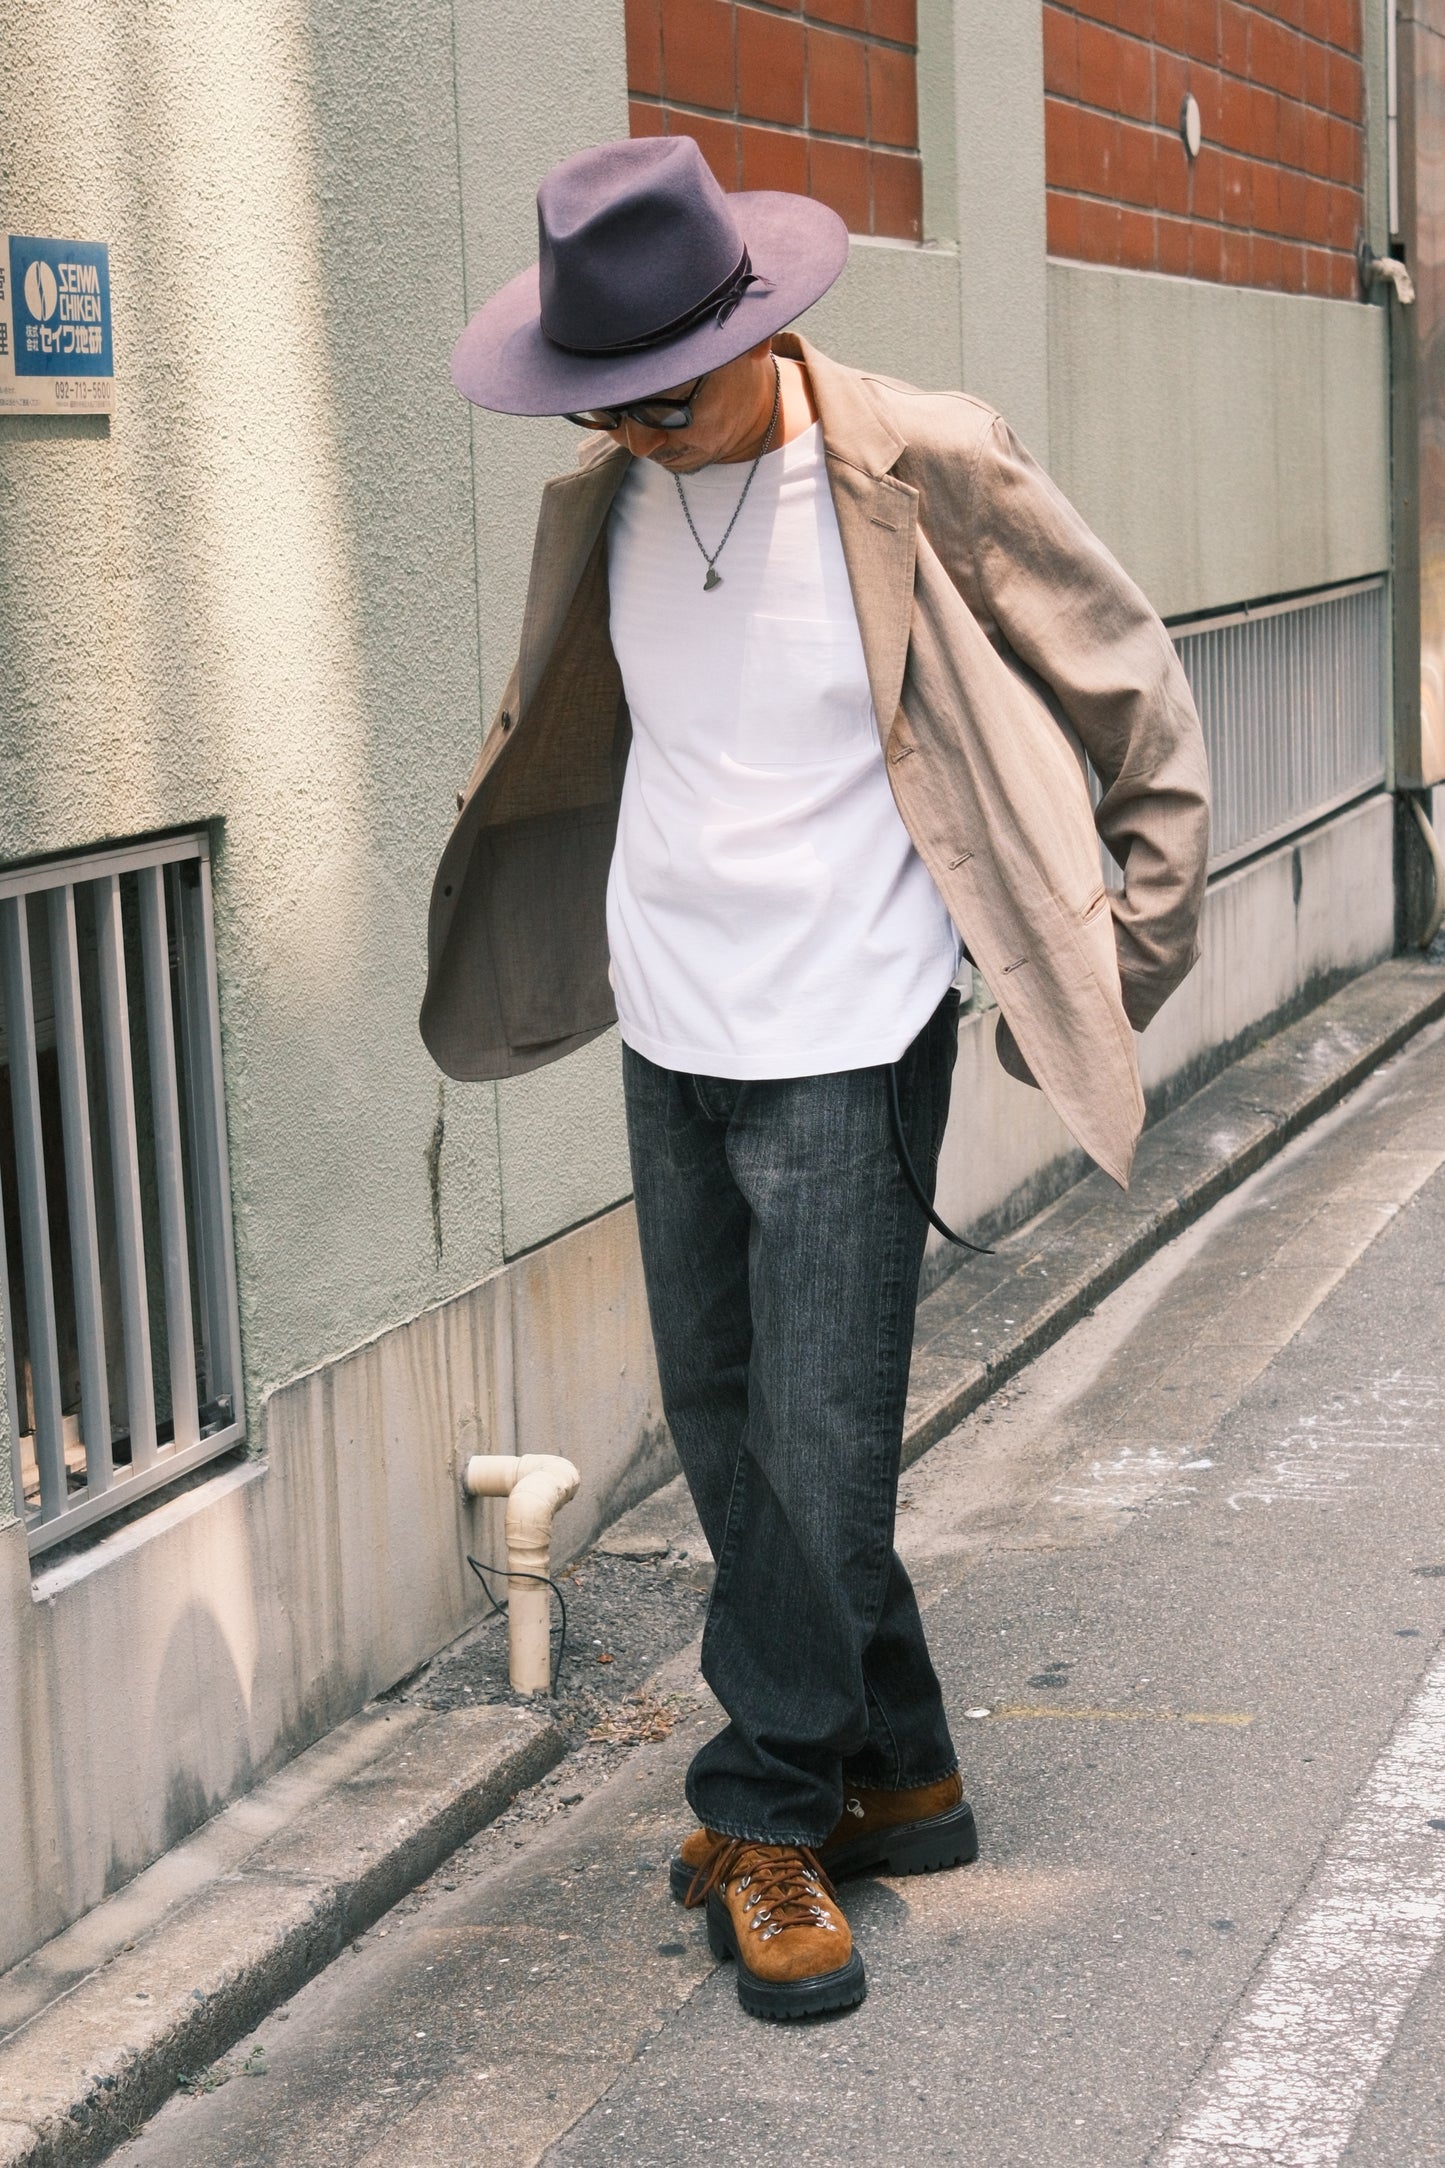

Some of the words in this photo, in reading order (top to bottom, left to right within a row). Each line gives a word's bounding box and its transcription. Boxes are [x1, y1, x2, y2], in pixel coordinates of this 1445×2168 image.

[58, 263, 100, 294] SEIWA
[59, 295, 102, 322] CHIKEN
[40, 324, 102, 354] セイワ地研
[55, 381, 111, 399] 092-713-5600
